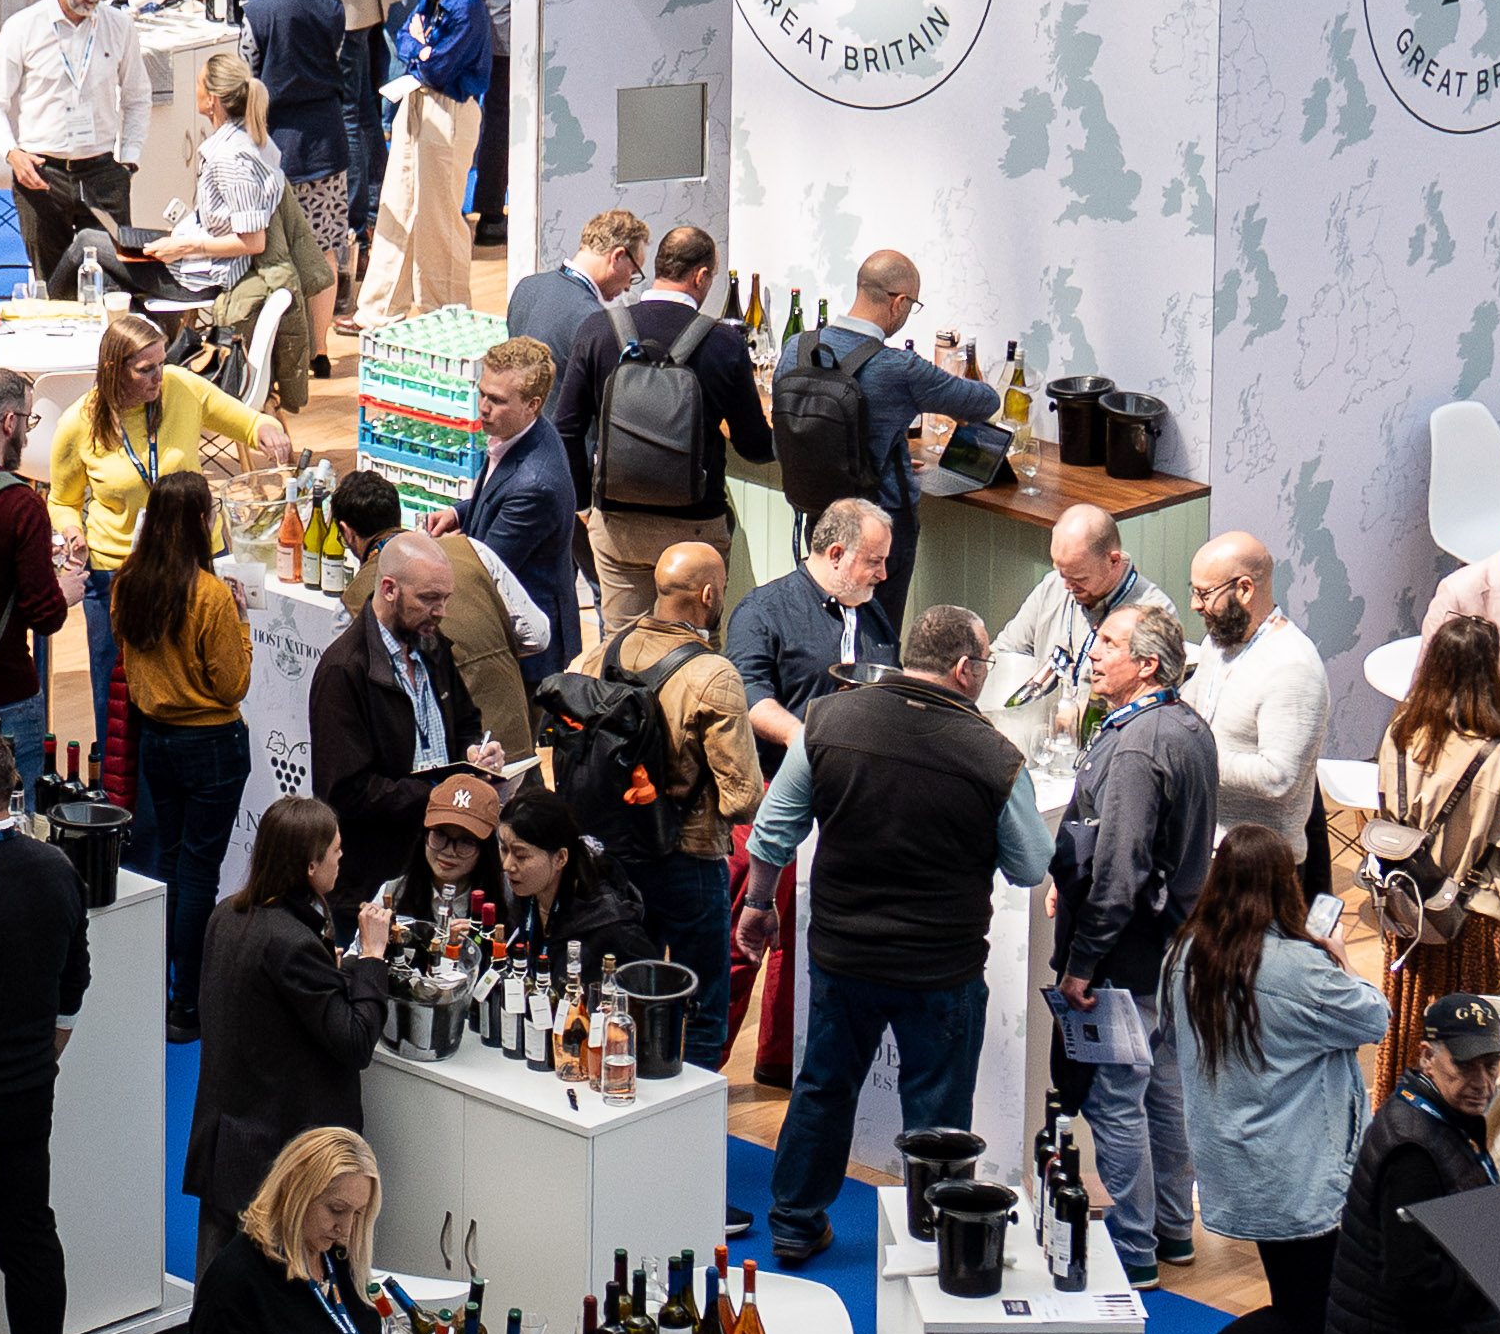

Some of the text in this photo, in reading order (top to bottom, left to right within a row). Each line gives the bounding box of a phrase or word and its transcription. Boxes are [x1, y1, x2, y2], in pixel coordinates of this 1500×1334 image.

[843, 4, 952, 74] BRITAIN
[1394, 26, 1469, 100] GREAT
[253, 628, 281, 648] HOST
